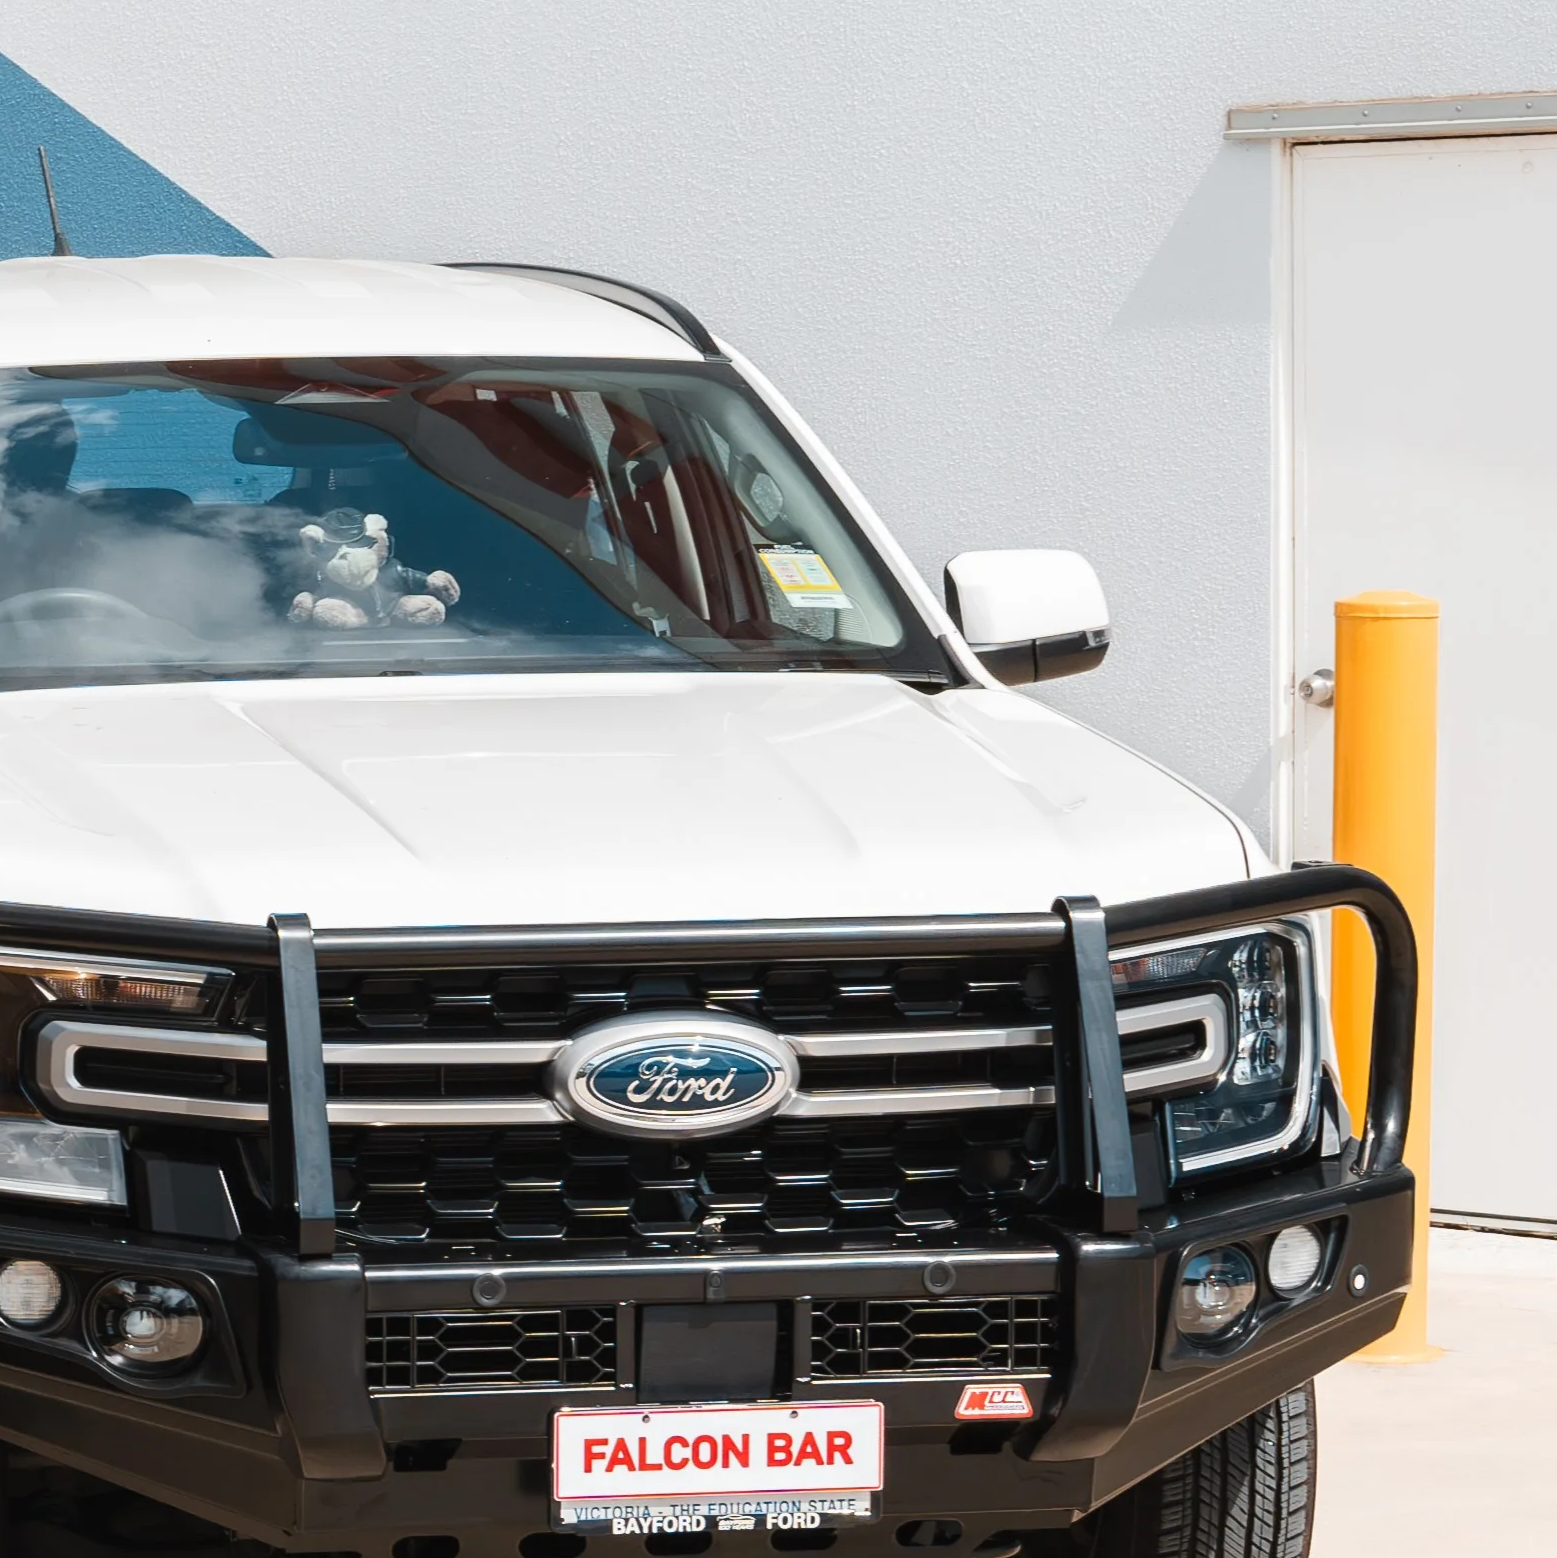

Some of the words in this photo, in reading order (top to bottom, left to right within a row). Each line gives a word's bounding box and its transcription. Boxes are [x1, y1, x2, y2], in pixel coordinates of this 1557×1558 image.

[627, 1056, 737, 1103] Ford
[583, 1433, 750, 1474] FALCON
[766, 1429, 854, 1468] BAR
[574, 1505, 652, 1521] VICTORIA
[708, 1500, 802, 1515] EDUCATION
[808, 1498, 856, 1513] STATE
[612, 1515, 707, 1535] BAYFORD
[766, 1512, 821, 1530] FORD
